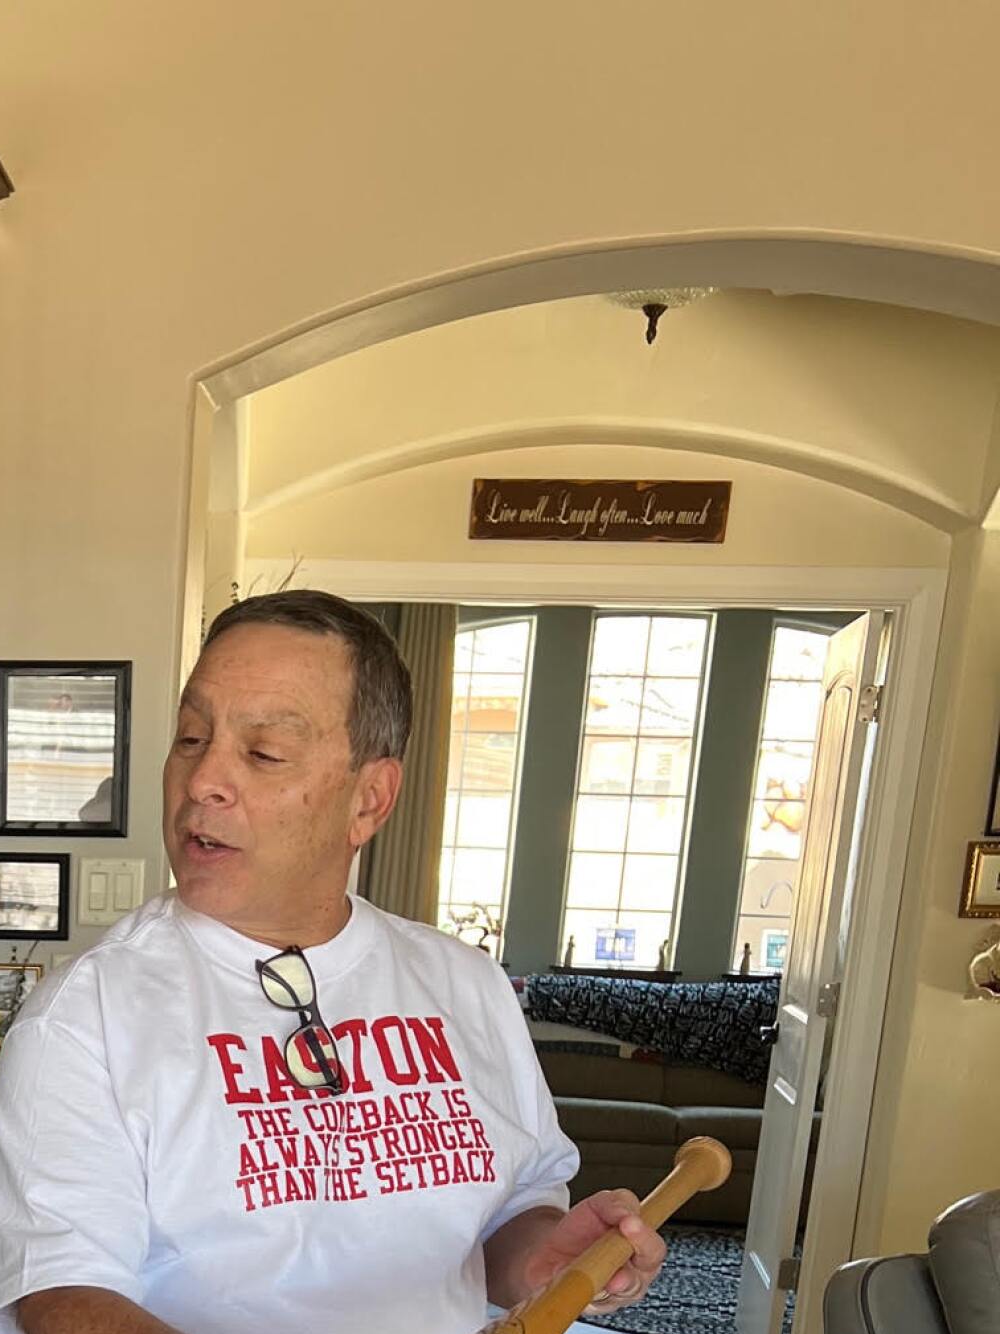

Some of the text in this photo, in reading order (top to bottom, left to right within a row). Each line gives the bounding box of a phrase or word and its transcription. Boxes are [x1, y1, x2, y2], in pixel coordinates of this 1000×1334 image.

[485, 489, 516, 523] Live
[207, 1015, 463, 1105] EASTON
[237, 1107, 299, 1140] THE
[441, 1088, 472, 1118] IS
[238, 1118, 490, 1176] ALWAYS STRONGER
[236, 1150, 497, 1212] THAN THE SETBACK
